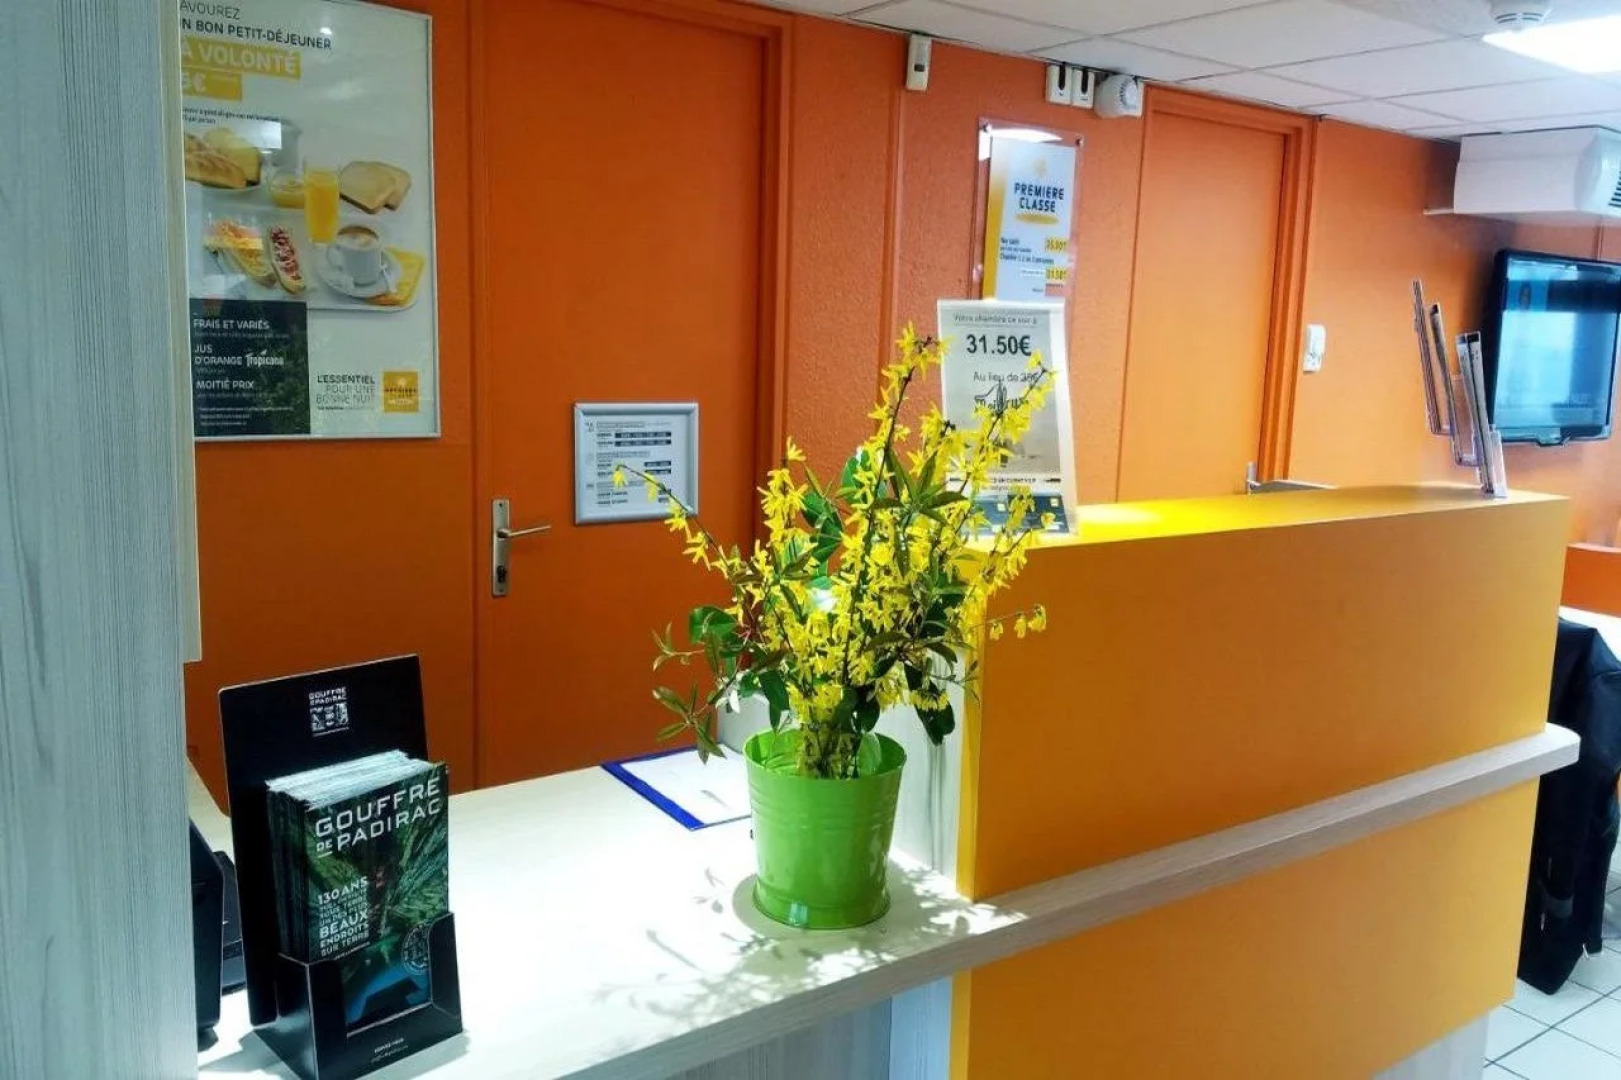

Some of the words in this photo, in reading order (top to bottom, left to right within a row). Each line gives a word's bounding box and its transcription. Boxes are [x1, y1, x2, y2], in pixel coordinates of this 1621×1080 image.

[180, 0, 241, 20] AVOUREZ
[181, 17, 191, 29] N
[195, 19, 224, 34] BON
[228, 24, 332, 49] PETIT-DÉJEUNER
[198, 44, 296, 73] VOLONTÉ
[1014, 182, 1065, 200] PREMIERE
[1019, 197, 1056, 213] CLASSE
[193, 319, 221, 329] FRAIS
[223, 320, 235, 329] ET
[236, 319, 270, 330] VARIÉS
[195, 343, 213, 354] JUS
[966, 334, 1032, 356] 31.50€
[195, 356, 243, 366] D'ORANGE
[245, 351, 285, 368] Tropicana
[196, 377, 230, 390] MOITIÉ
[232, 380, 255, 390] PRIX
[317, 374, 376, 384] L'ESSENTIEL
[974, 371, 986, 382] Au
[315, 777, 441, 838] GOUFFRE
[316, 838, 333, 852] DE
[337, 798, 441, 851] PADIRAC
[341, 876, 368, 897] ANS
[319, 908, 368, 939] BEAUX
[320, 922, 369, 949] ENDROITS
[321, 943, 339, 957] SUR
